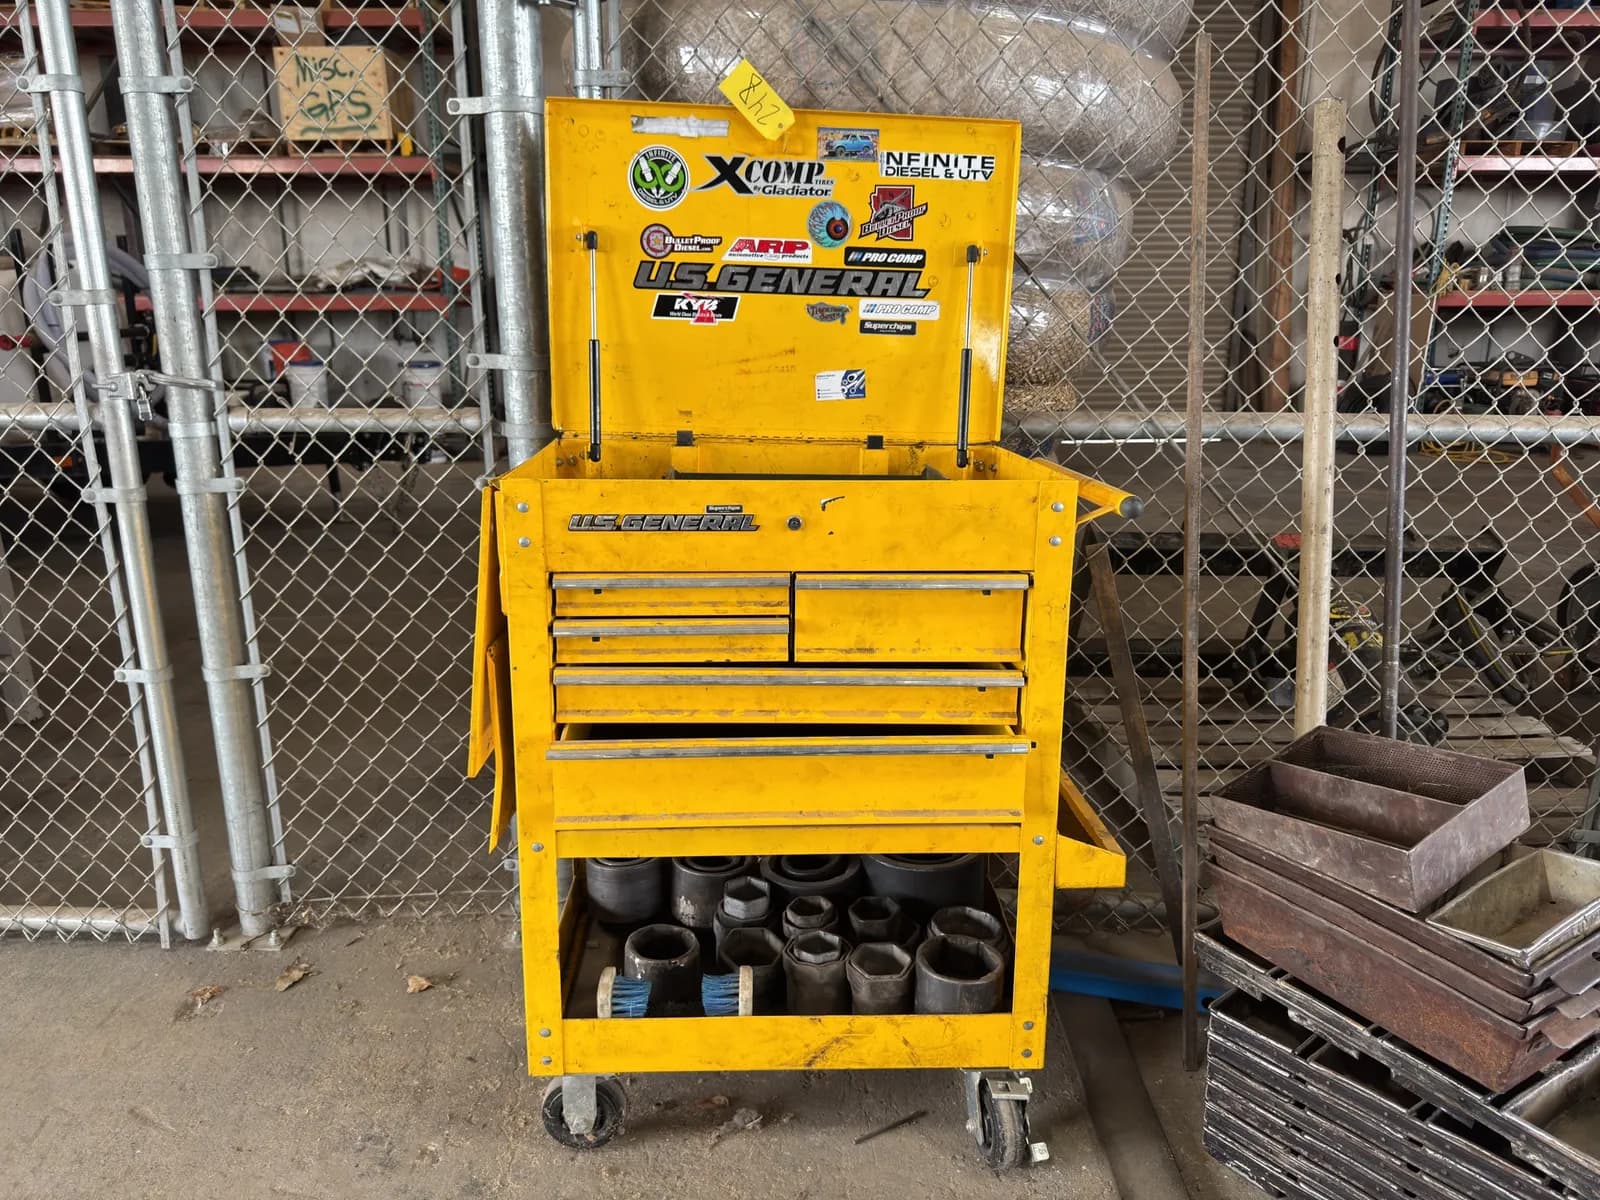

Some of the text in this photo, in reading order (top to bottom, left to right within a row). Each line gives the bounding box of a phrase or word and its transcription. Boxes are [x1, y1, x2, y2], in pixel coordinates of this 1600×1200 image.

[294, 55, 354, 88] Misc.
[300, 88, 372, 123] GPS
[738, 72, 781, 126] 248
[645, 149, 677, 163] INFINITE
[885, 166, 995, 181] DIESEL & UTV
[762, 184, 832, 197] Gladiator
[730, 238, 809, 254] ARP
[862, 252, 924, 264] PRO COMP
[715, 264, 931, 298] GENERAL
[673, 297, 719, 311] KYB
[876, 303, 937, 315] PRO COMP
[863, 321, 912, 332] Superchips
[620, 514, 761, 531] GENERAL
